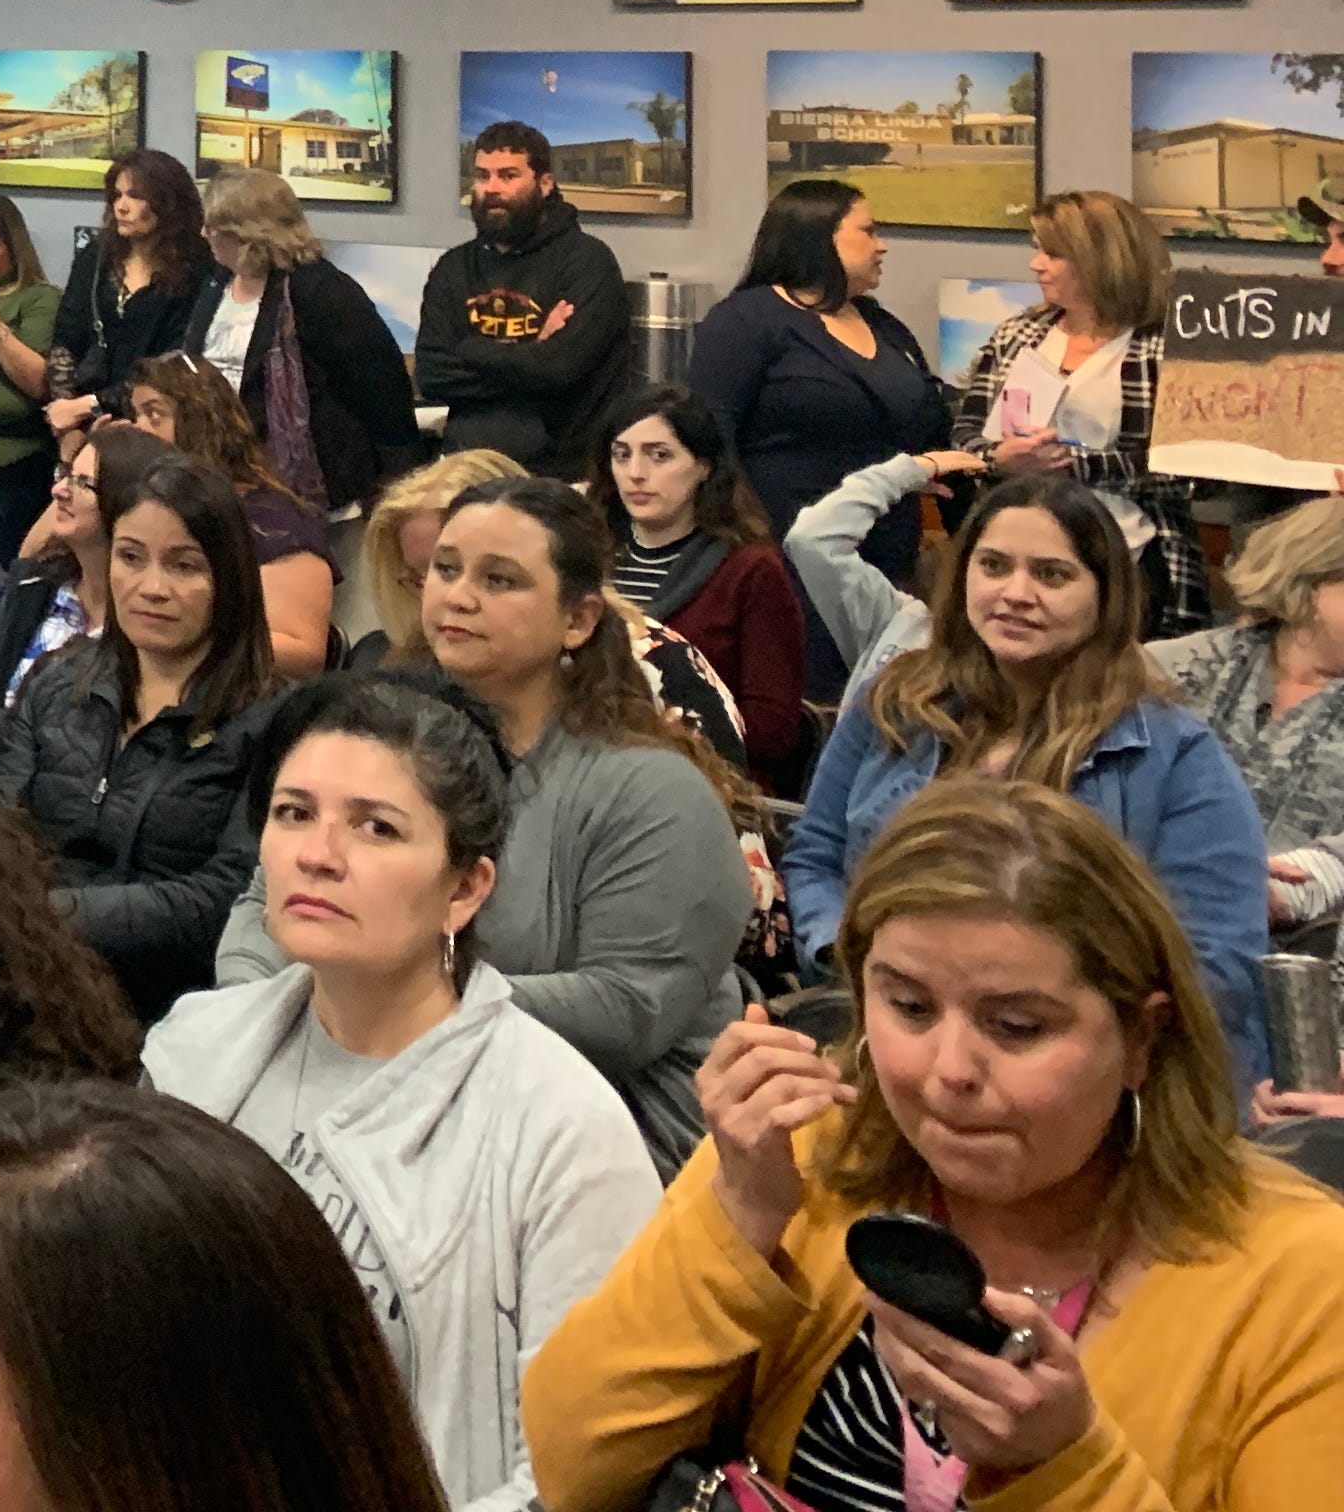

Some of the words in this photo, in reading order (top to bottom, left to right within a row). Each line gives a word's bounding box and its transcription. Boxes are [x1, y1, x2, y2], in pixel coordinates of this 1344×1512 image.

[779, 112, 867, 127] SIERRA
[874, 117, 944, 130] LINDA
[816, 126, 911, 143] SCHOOL
[1175, 288, 1278, 340] CUTS
[1292, 305, 1332, 341] IN
